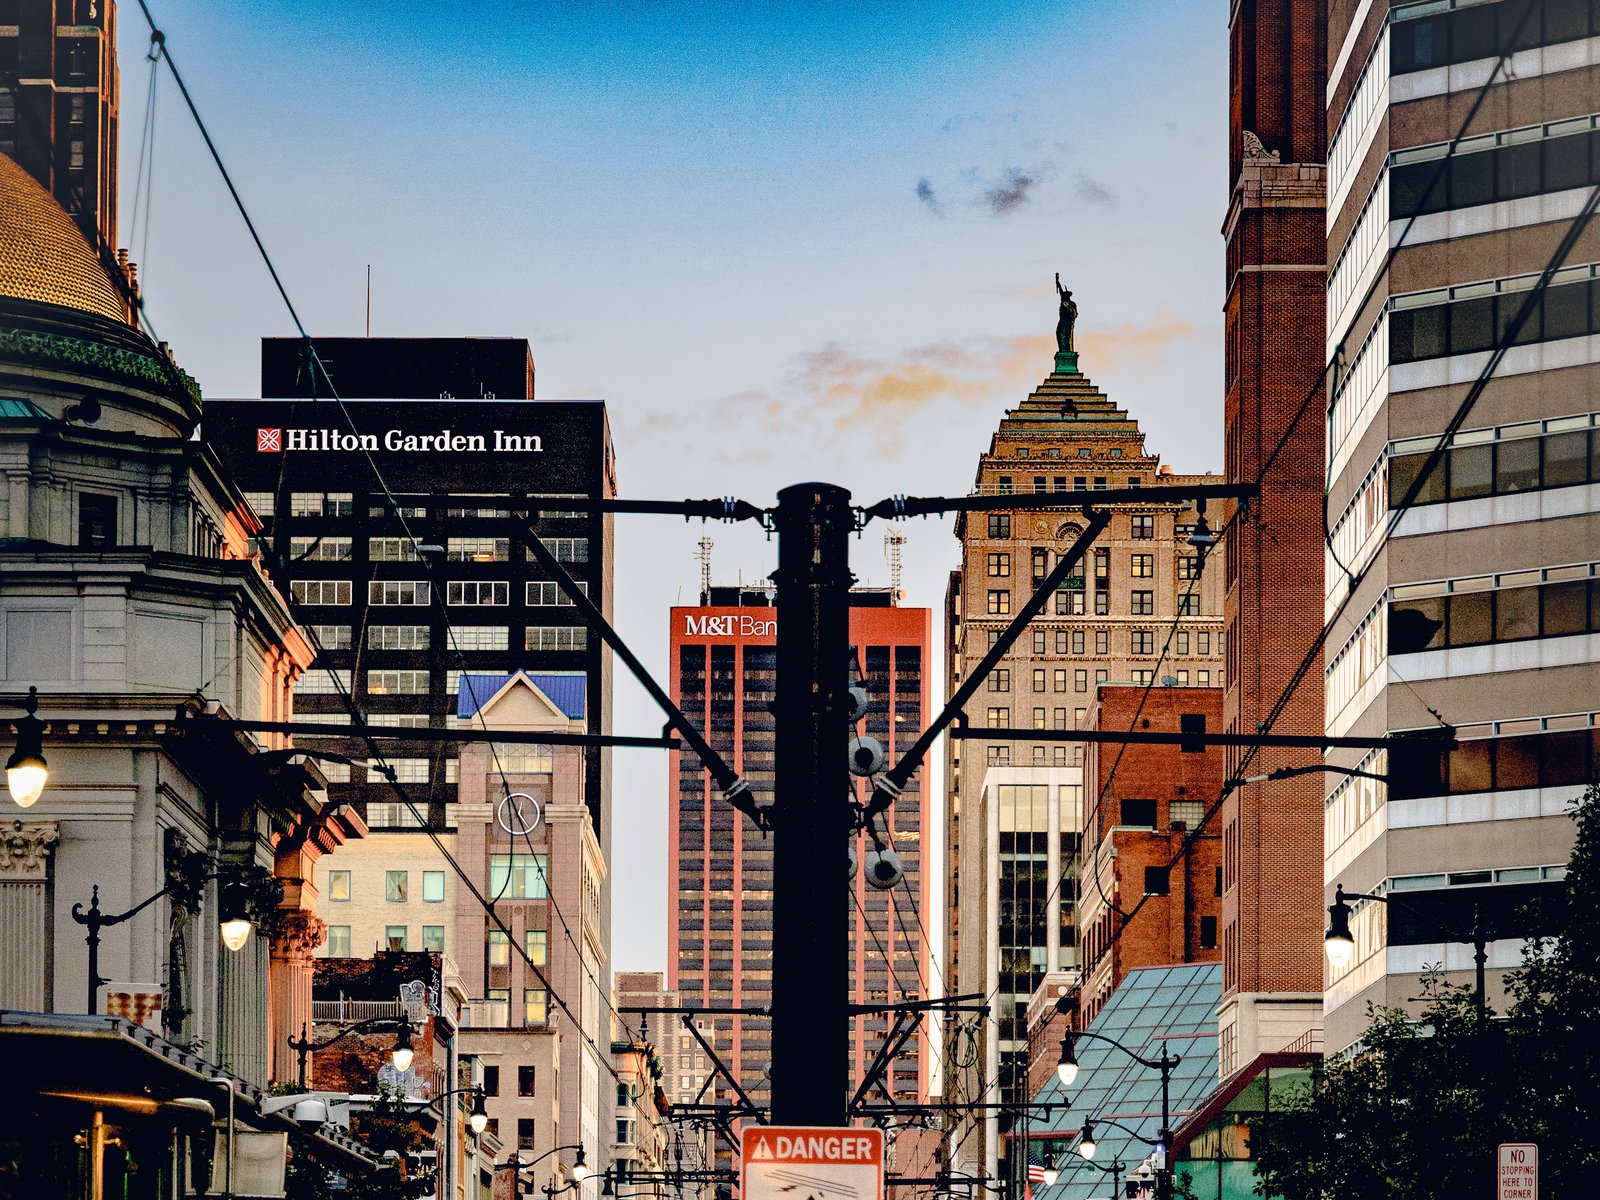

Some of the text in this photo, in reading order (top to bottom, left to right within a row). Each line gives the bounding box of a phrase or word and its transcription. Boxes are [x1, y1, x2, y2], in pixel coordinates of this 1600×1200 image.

[286, 430, 543, 452] Hilton Garden Inn
[685, 615, 777, 636] M&T Ban
[775, 1136, 872, 1160] DANGER
[1511, 1150, 1525, 1163] NO
[1501, 1166, 1534, 1175] STOPPING
[1502, 1178, 1533, 1187] HERE TO
[1503, 1190, 1532, 1199] CORNER
